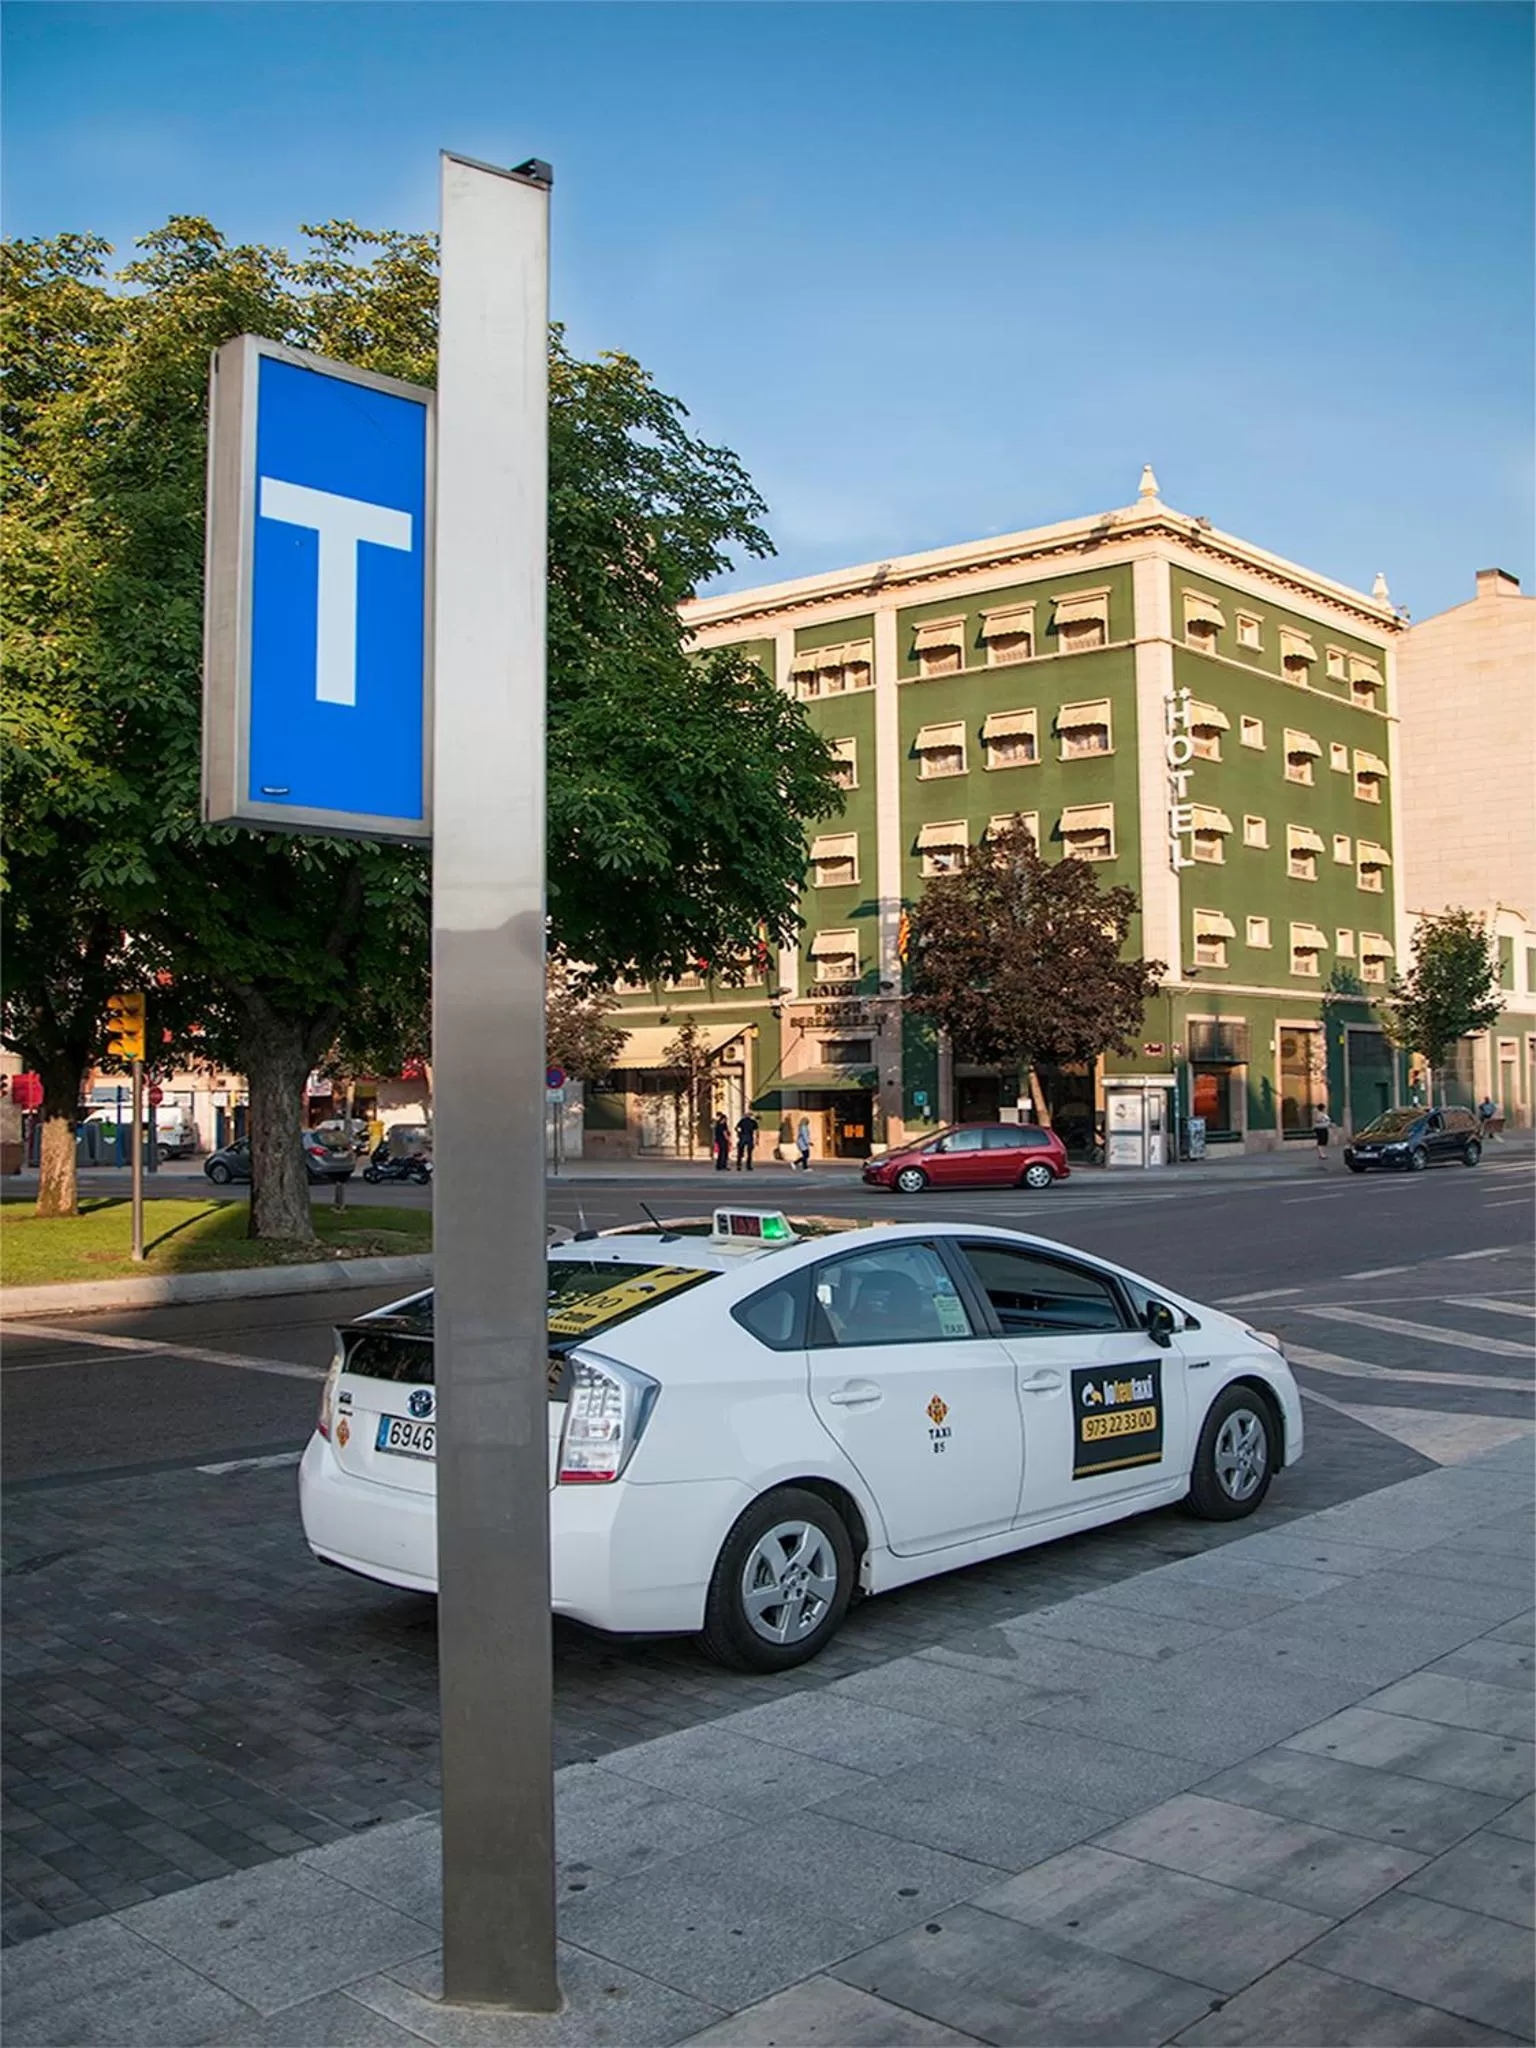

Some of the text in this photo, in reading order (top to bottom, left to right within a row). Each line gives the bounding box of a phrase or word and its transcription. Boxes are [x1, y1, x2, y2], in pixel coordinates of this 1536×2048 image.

[260, 475, 413, 708] T
[1167, 699, 1196, 869] HOTEL
[390, 1421, 436, 1452] 6946
[928, 1426, 952, 1440] TAXI
[1086, 1410, 1153, 1438] 973 22 33 00
